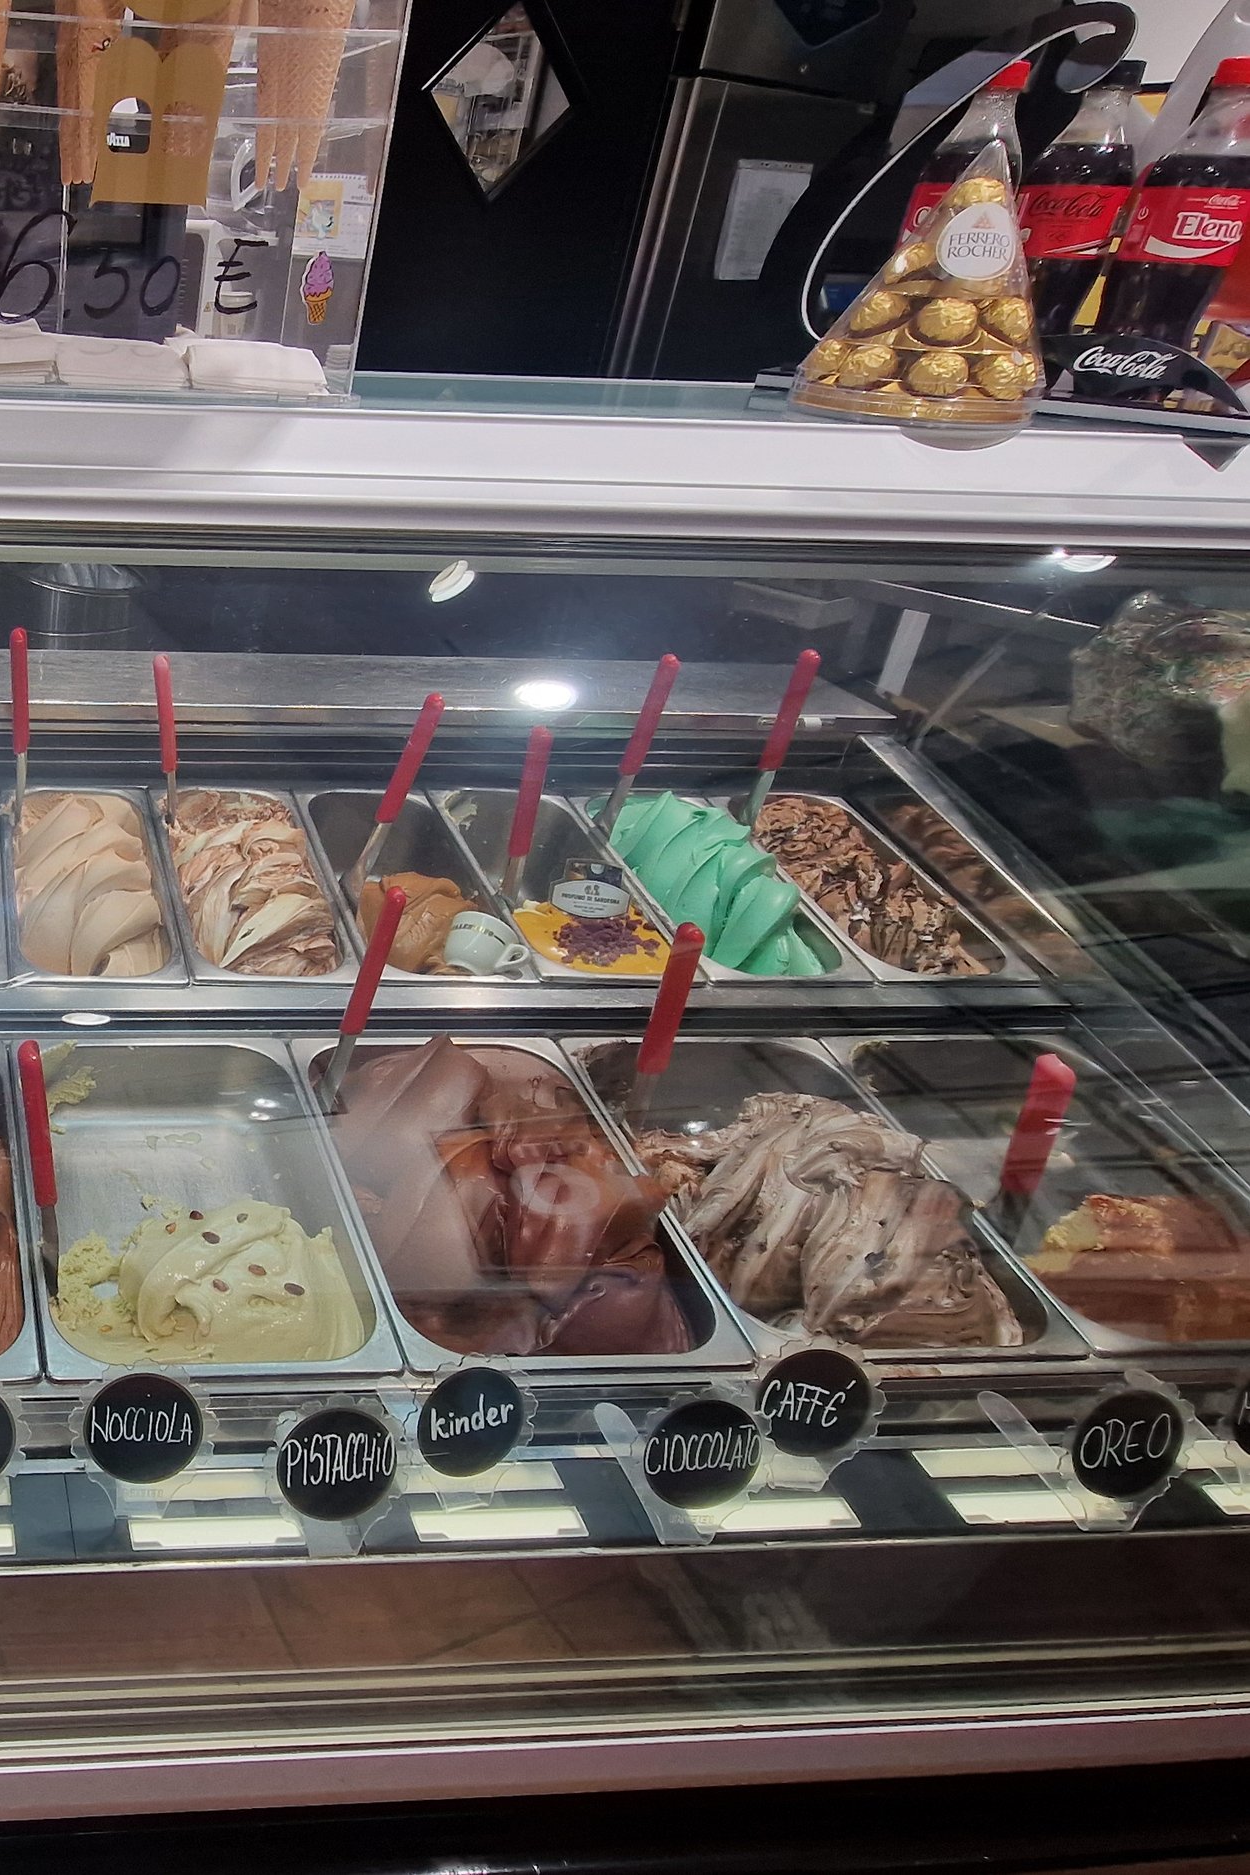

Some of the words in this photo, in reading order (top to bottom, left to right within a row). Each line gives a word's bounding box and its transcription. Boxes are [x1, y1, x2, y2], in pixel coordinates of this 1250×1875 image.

[949, 231, 1011, 248] FERRERO
[1174, 212, 1243, 242] Elena
[947, 245, 1008, 262] ROCHER
[1073, 345, 1180, 381] Coca-Cola
[90, 1400, 194, 1446] NOCCIOLA
[430, 1392, 515, 1442] kinder
[643, 1424, 762, 1476] CIOCCOLATO
[1079, 1412, 1172, 1470] OREO
